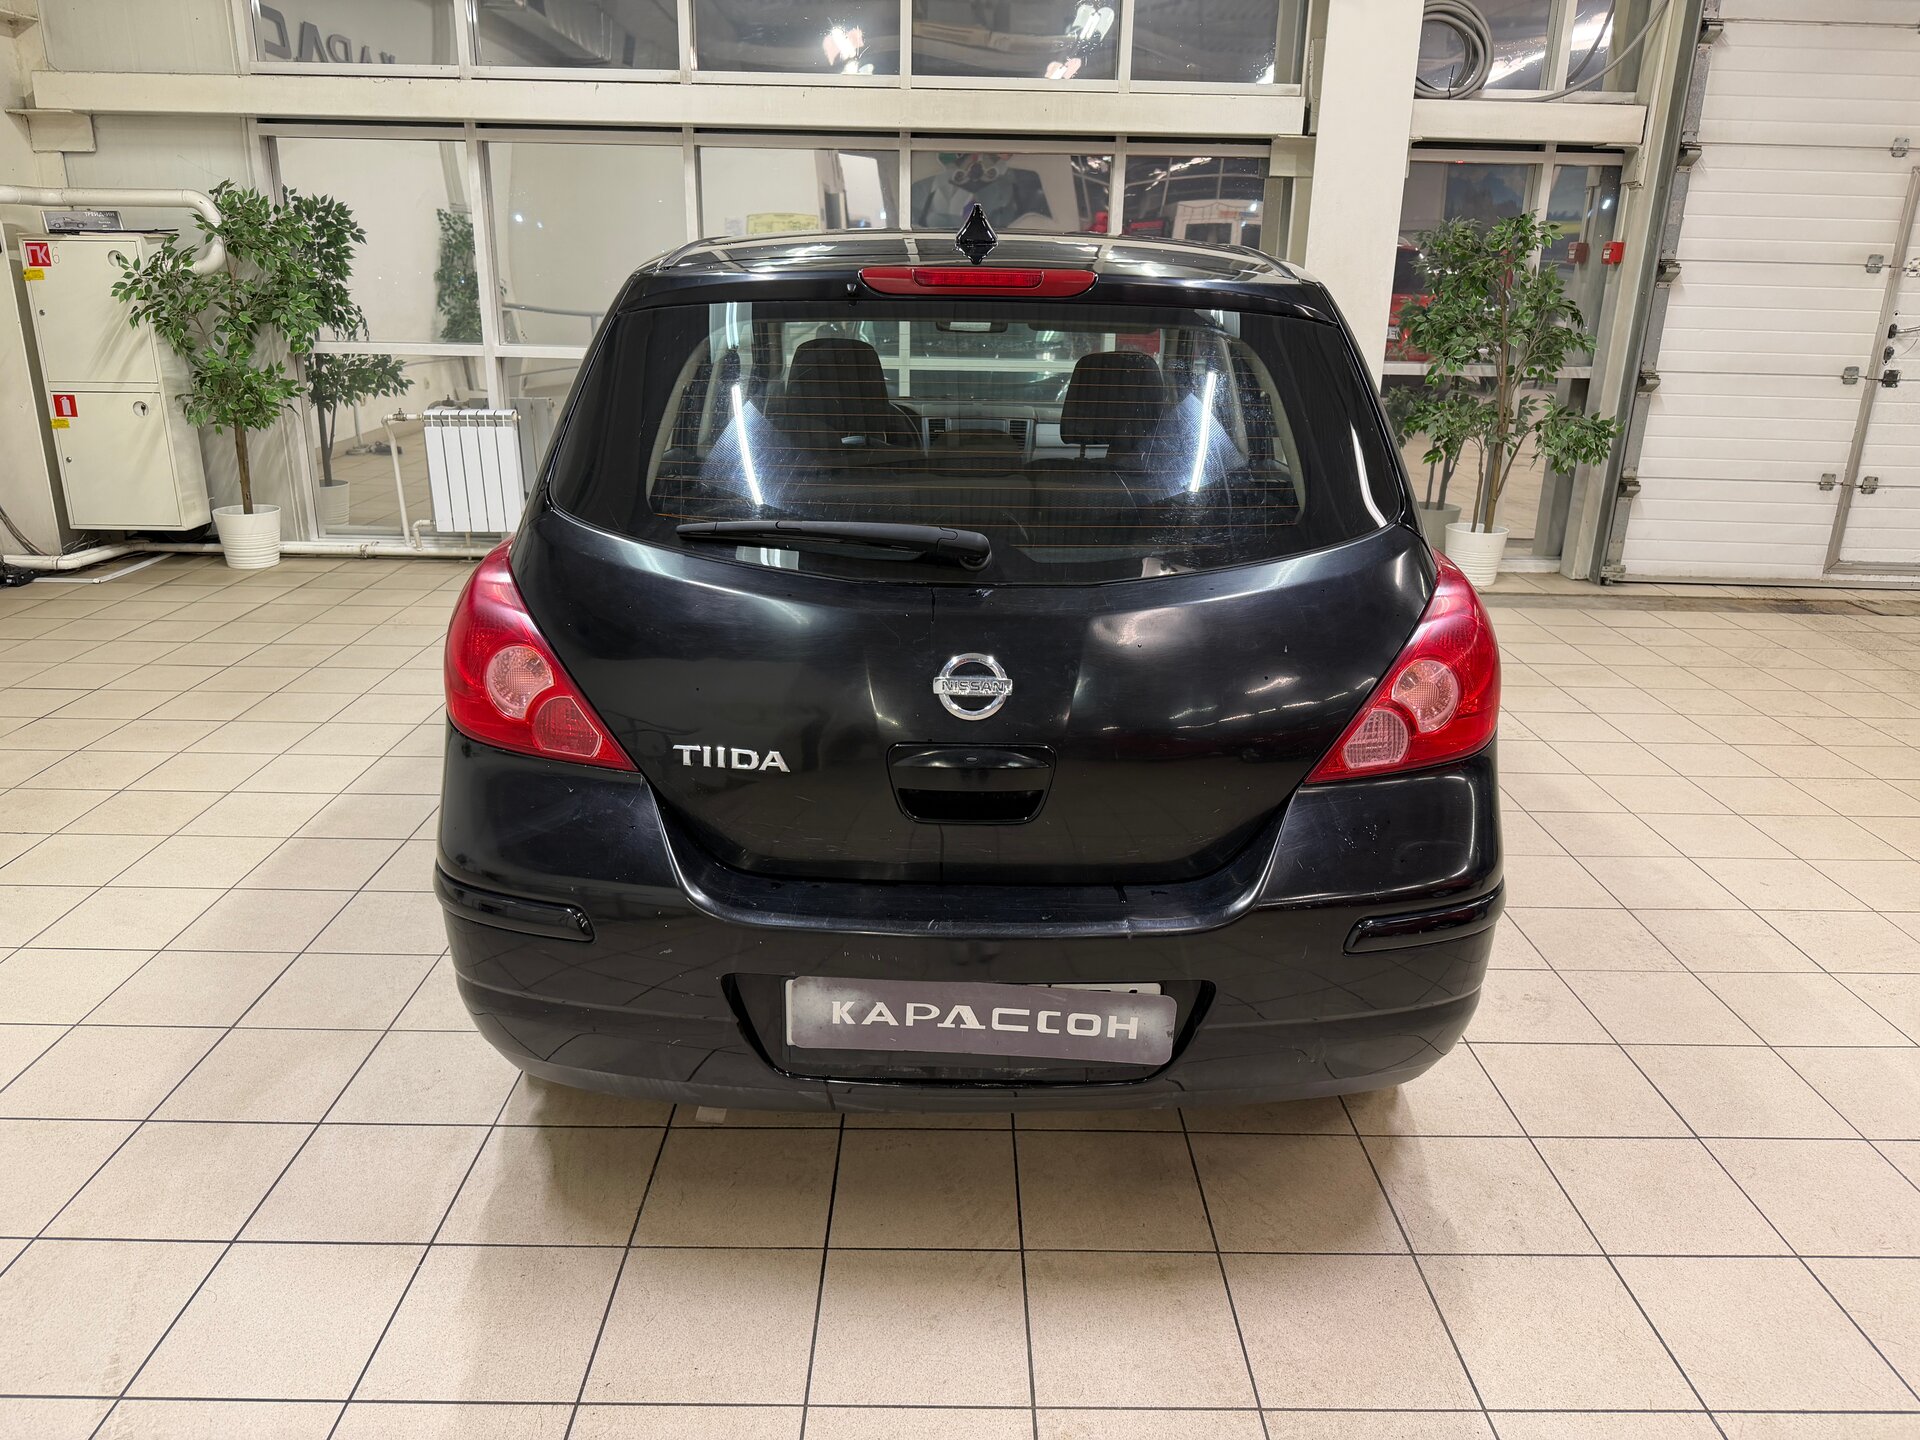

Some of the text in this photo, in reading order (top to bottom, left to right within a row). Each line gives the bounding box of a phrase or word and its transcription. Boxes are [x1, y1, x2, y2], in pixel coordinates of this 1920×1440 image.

[26, 245, 50, 264] ПК
[941, 680, 1005, 692] NISSAN
[672, 744, 791, 773] TIIDA
[831, 1000, 1139, 1040] КАРАССОН
